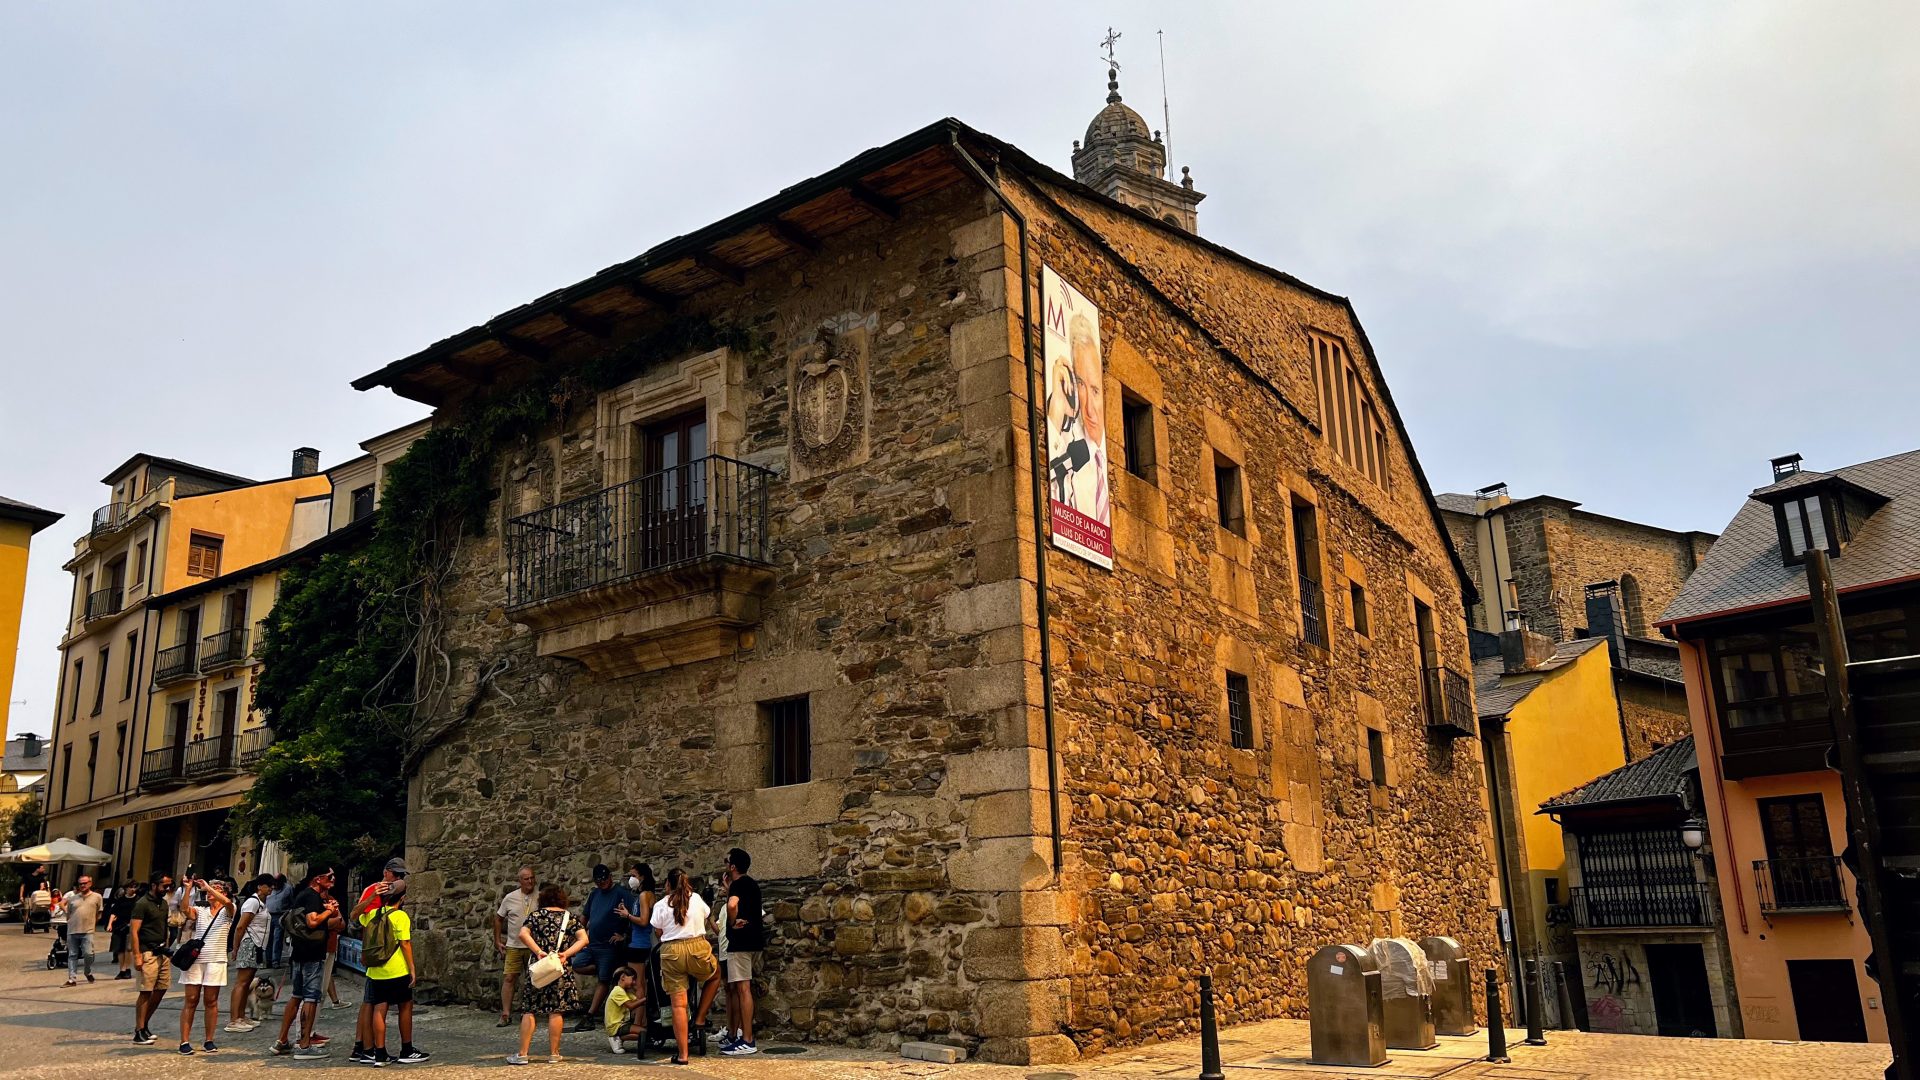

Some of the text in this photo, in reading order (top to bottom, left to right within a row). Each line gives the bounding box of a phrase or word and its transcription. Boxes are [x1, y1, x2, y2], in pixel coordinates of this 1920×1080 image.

[1047, 295, 1066, 337] M
[1054, 505, 1107, 539] MUSEO DE LA RADIO
[1060, 525, 1104, 553] LUIS DEL OLMO
[223, 671, 235, 681] LA
[196, 679, 208, 731] HOSTAL
[127, 800, 214, 824] HOSTAL VIRGEN DE LA ENCINA
